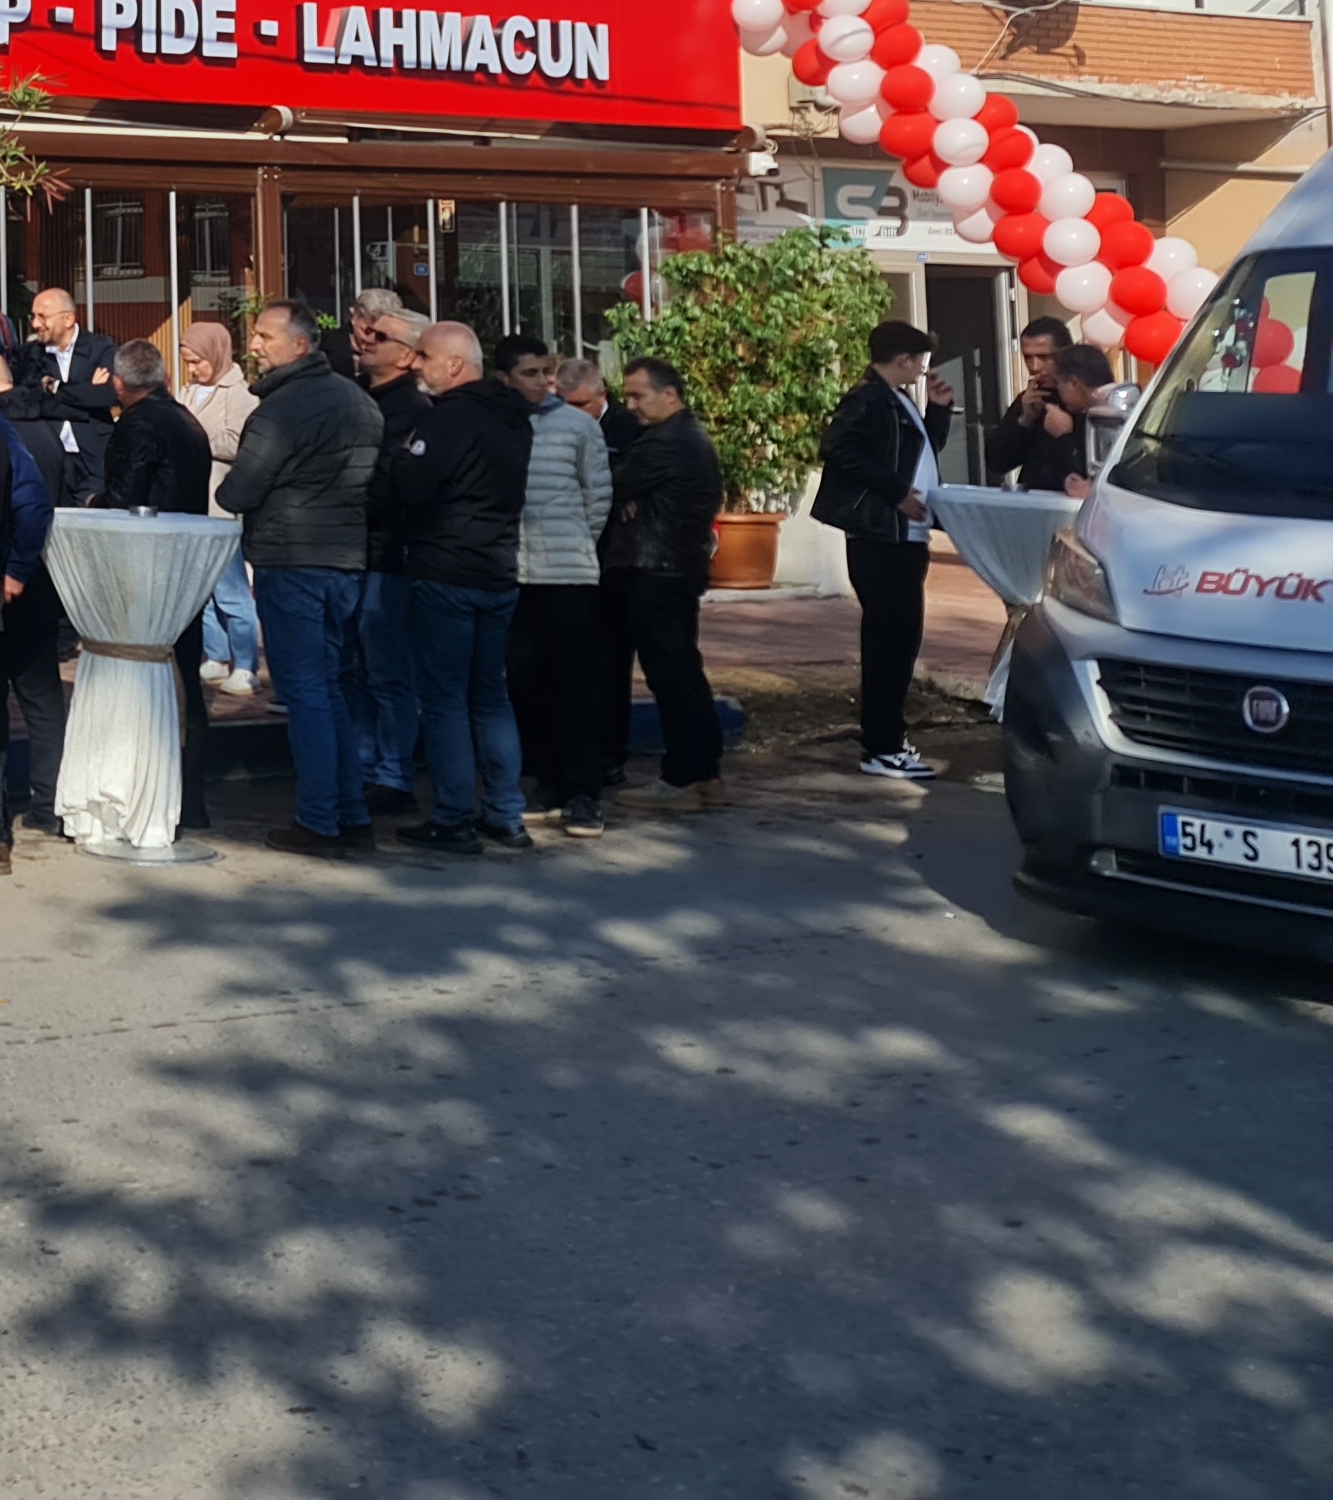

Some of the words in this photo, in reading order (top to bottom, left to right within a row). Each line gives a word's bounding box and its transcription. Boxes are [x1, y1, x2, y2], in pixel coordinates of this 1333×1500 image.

[302, 1, 610, 81] LAHMACUN
[1181, 821, 1214, 855] 54
[1242, 830, 1259, 862] S
